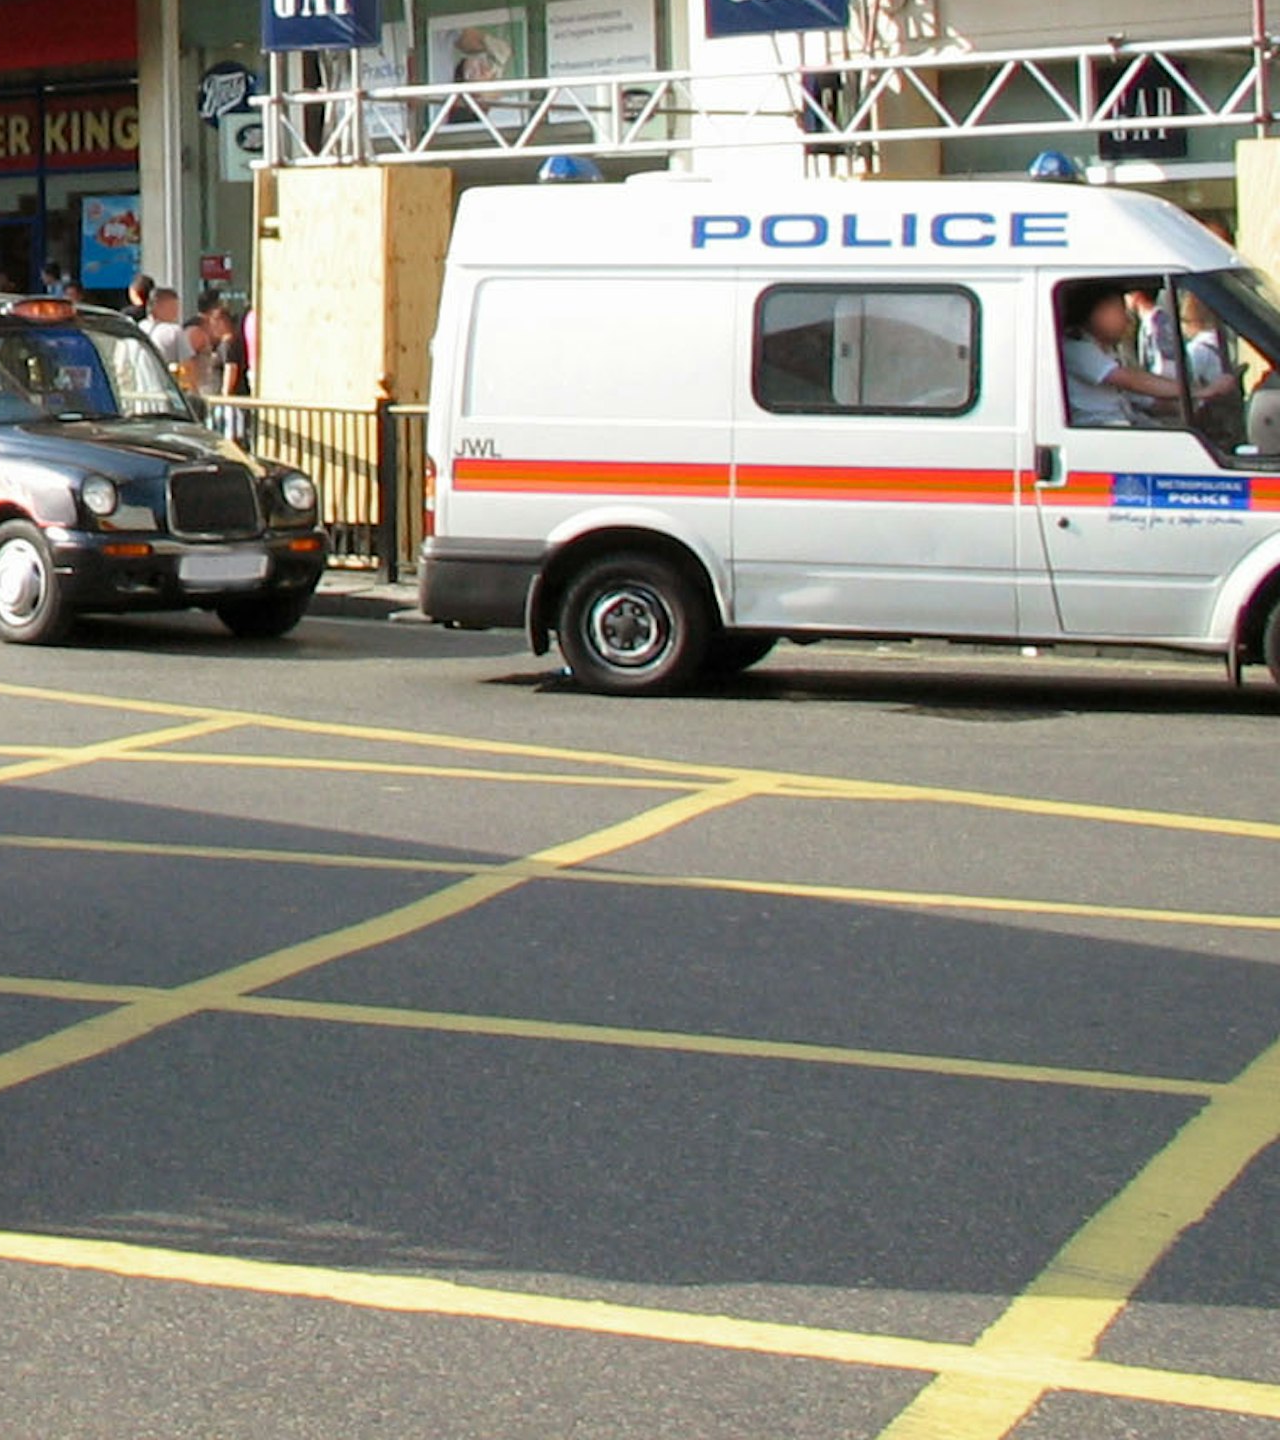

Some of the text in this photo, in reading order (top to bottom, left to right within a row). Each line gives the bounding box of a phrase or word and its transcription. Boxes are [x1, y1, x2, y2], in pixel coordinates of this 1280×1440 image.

[43, 106, 140, 155] KING
[690, 211, 1070, 250] POLICE
[453, 436, 503, 459] JWL
[1167, 492, 1231, 506] POLICE
